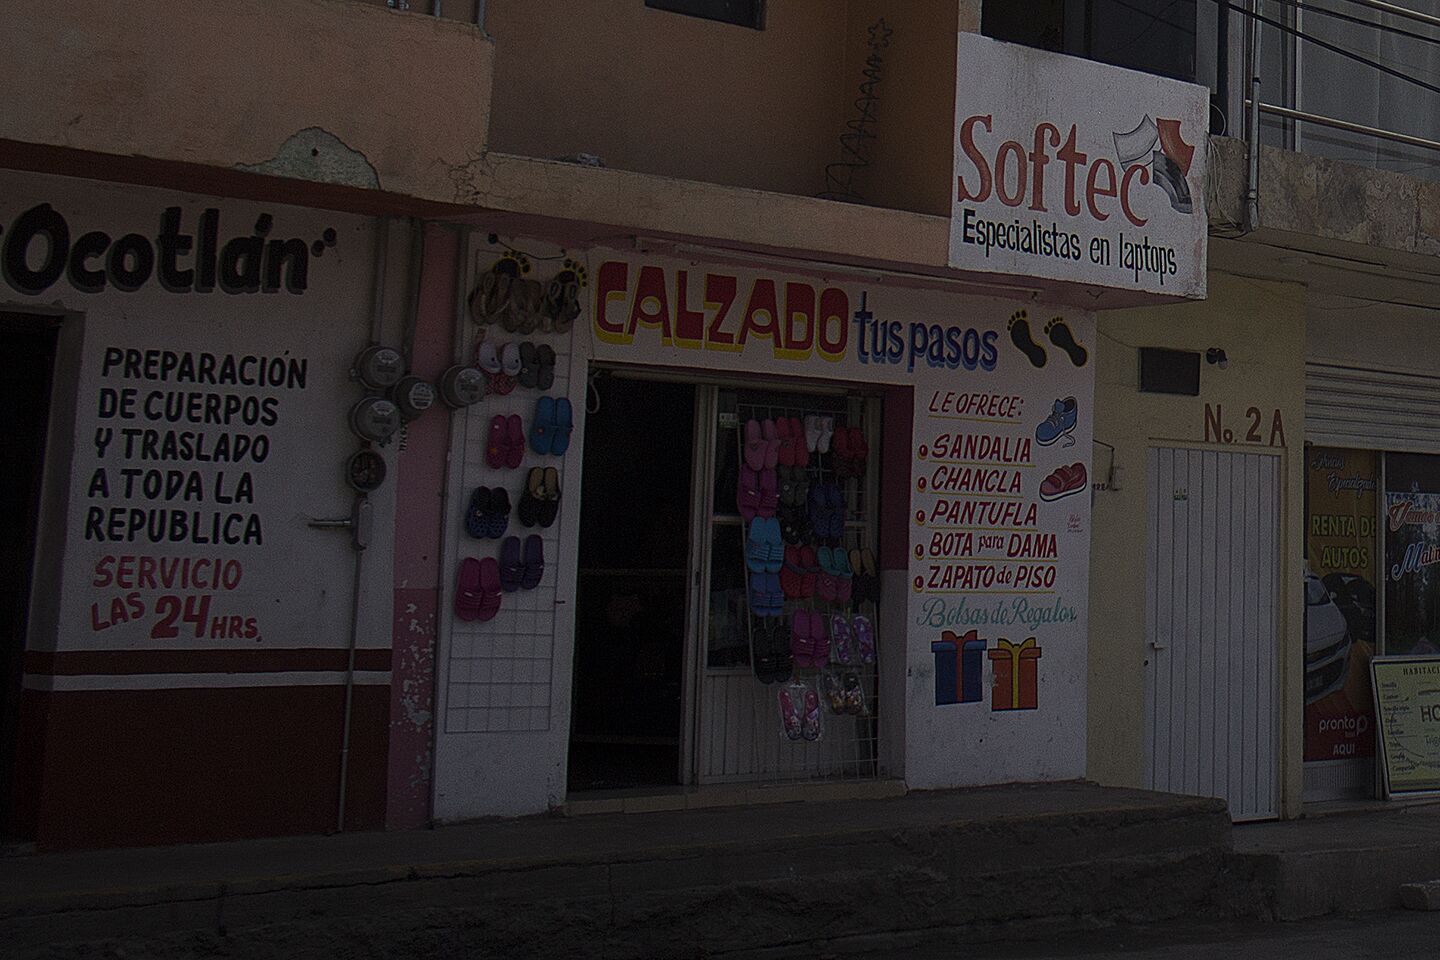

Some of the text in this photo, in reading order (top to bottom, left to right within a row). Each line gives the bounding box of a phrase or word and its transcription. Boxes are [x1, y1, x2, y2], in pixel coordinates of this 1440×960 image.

[957, 114, 1149, 227] Softec
[962, 208, 1178, 285] Especialistas en laptops
[593, 261, 1000, 373] CALZADO tus pasos
[102, 346, 308, 390] PREPARACIÓN
[98, 389, 279, 427] DE CUERPOS
[928, 389, 1025, 418] LE OFRECE:
[94, 428, 270, 464] Y TRASLADO
[931, 433, 1033, 464] SANDALIA
[88, 468, 254, 504] A TODA LA
[930, 465, 1023, 495] CHANCLA
[85, 506, 263, 546] REPUBLICA
[929, 499, 1039, 528] PANTUFLA
[1312, 514, 1376, 538] RENTA DE
[928, 532, 1059, 559] BOTA para DAMA
[1321, 545, 1369, 569] AUTOS
[94, 555, 243, 590] SERVICIO
[927, 565, 1057, 589] ZAPATO de PISO
[90, 591, 263, 643] LAS 24 HRS.
[916, 597, 990, 628] Bolsas
[990, 599, 1008, 626] de
[1319, 715, 1356, 734] pronto
